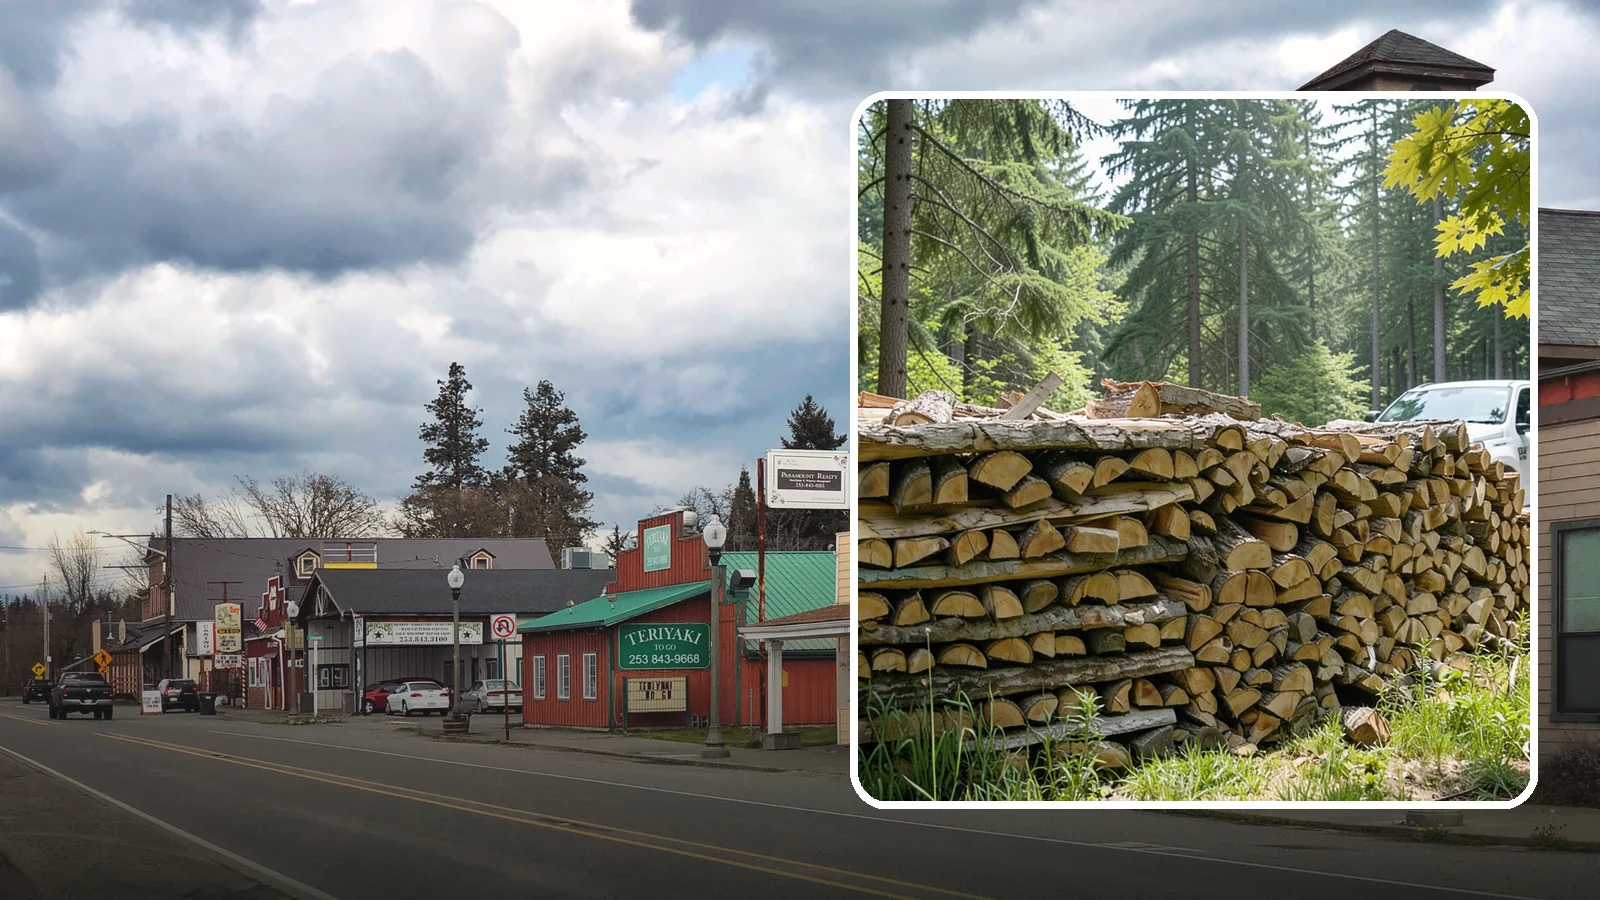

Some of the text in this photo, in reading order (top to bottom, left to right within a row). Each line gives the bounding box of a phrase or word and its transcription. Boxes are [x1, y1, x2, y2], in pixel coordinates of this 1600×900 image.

[781, 471, 839, 480] PARAMOUNT REALTY
[624, 627, 702, 646] TERIYAKI
[654, 643, 676, 651] TO GO
[628, 653, 700, 665] 253 843-9668
[639, 681, 672, 691] TERIYAKI
